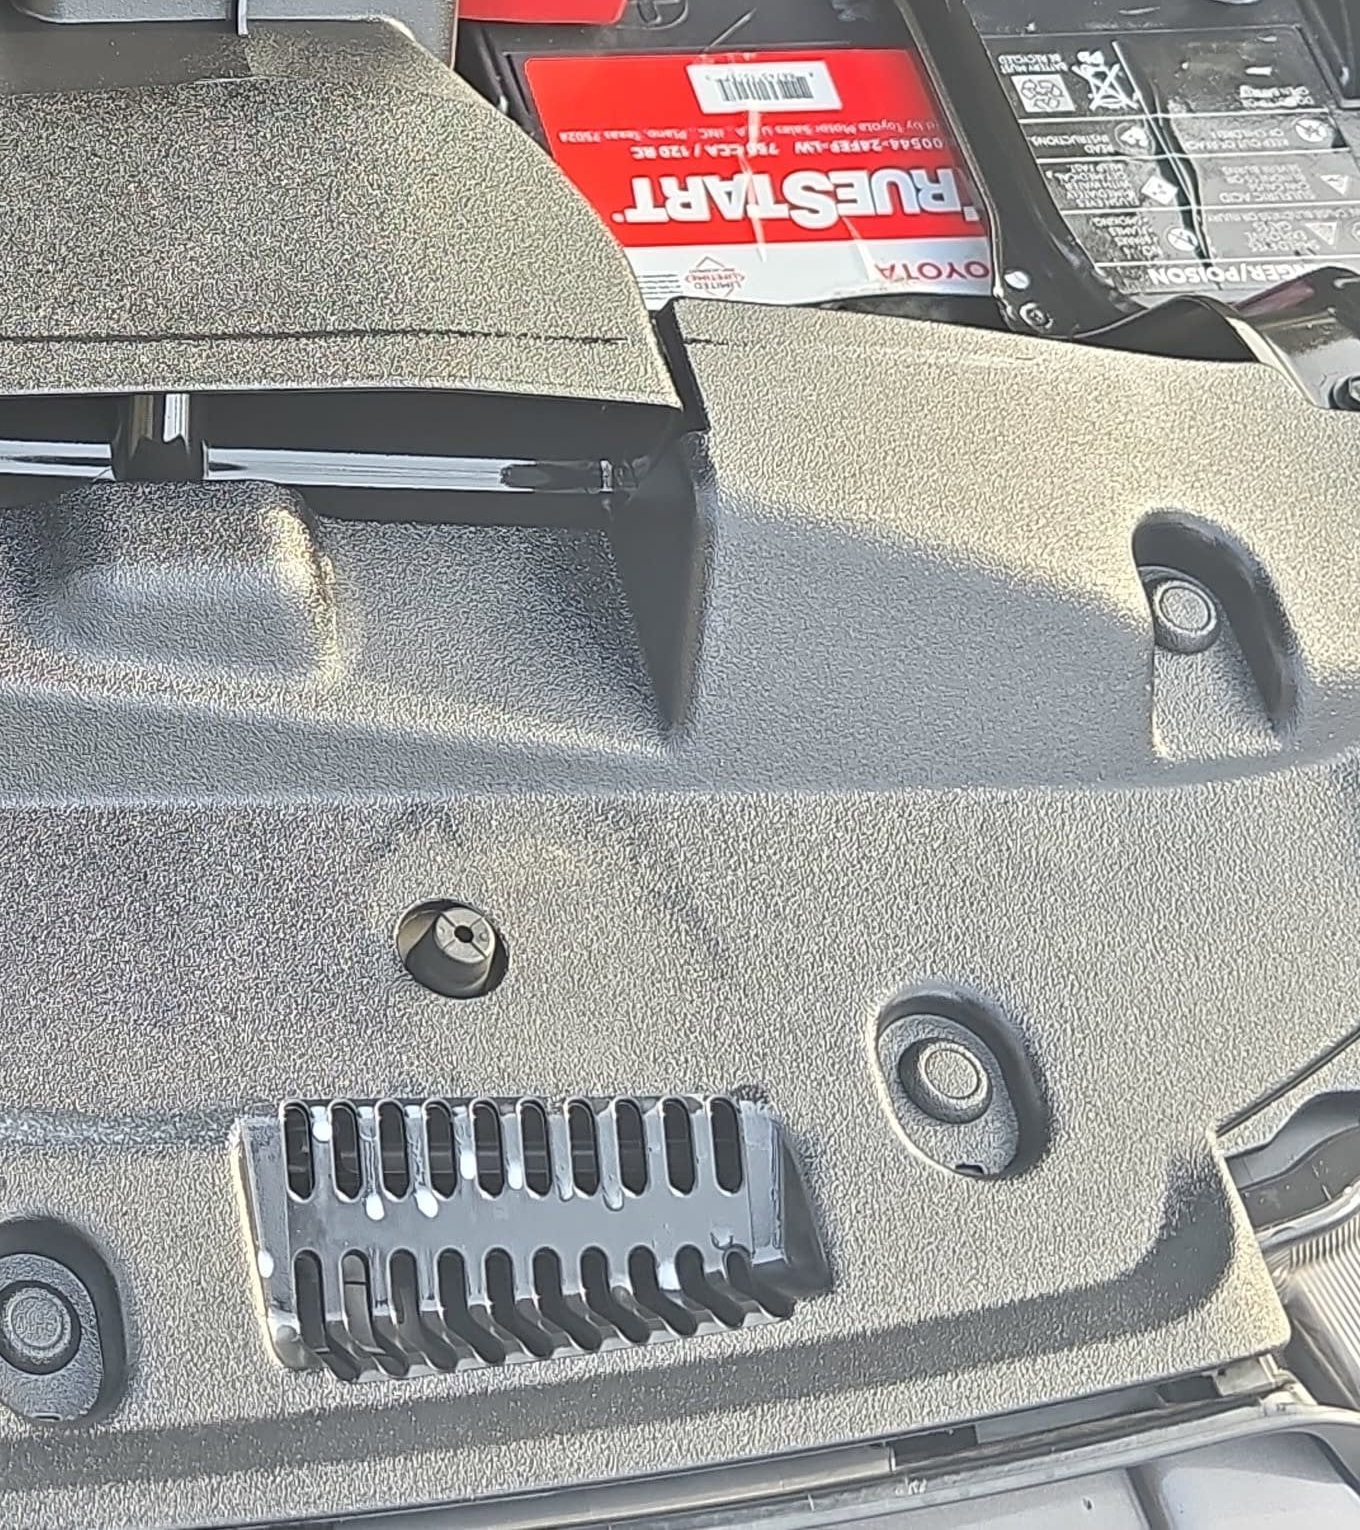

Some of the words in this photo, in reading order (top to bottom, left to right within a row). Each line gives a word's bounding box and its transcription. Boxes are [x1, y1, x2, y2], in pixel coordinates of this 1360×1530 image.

[775, 124, 811, 137] Sales
[814, 123, 857, 136] Motor
[857, 119, 902, 135] Toyota
[558, 130, 601, 143] 75024
[603, 129, 642, 142] Texas
[630, 145, 657, 160] RC
[658, 145, 690, 159] 120
[704, 143, 744, 157] CCA
[1219, 192, 1251, 203] ACID
[873, 260, 991, 281] OYOTA
[1147, 263, 1307, 286] NGER/POISON
[693, 280, 742, 290] LIMITED
